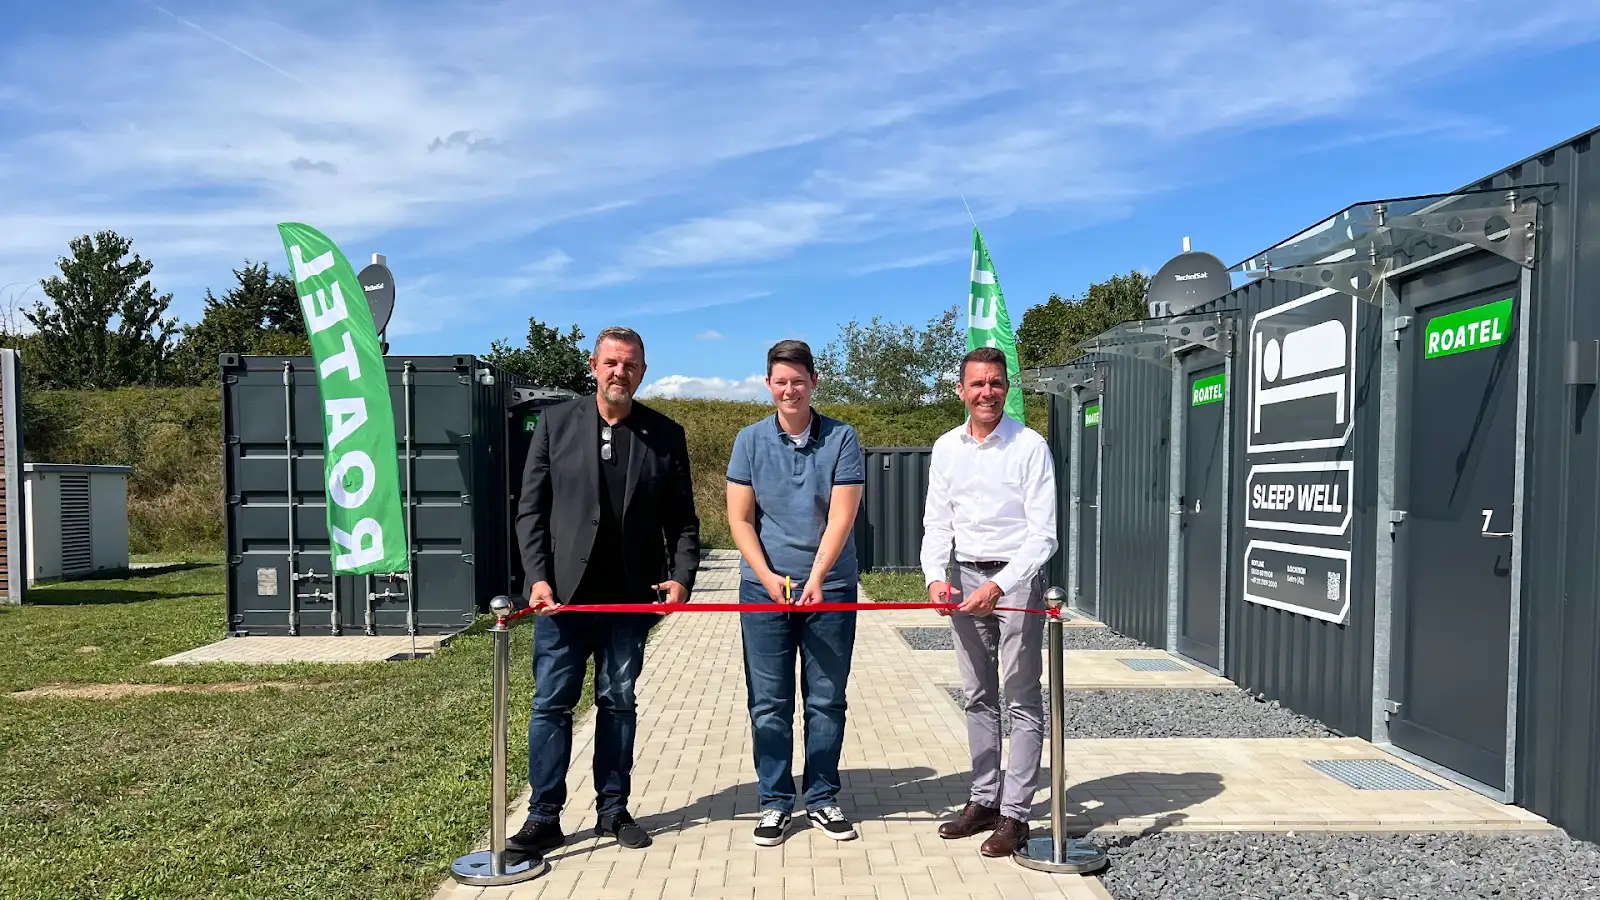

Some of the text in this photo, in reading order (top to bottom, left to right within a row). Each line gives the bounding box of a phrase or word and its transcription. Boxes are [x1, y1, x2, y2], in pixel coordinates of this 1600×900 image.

[1174, 271, 1208, 281] TechniSat
[1428, 317, 1502, 354] ROATEL
[1193, 384, 1222, 403] ROATEL
[1195, 499, 1200, 513] 6
[1252, 483, 1342, 513] SLEEP WELL
[1481, 510, 1494, 531] 7
